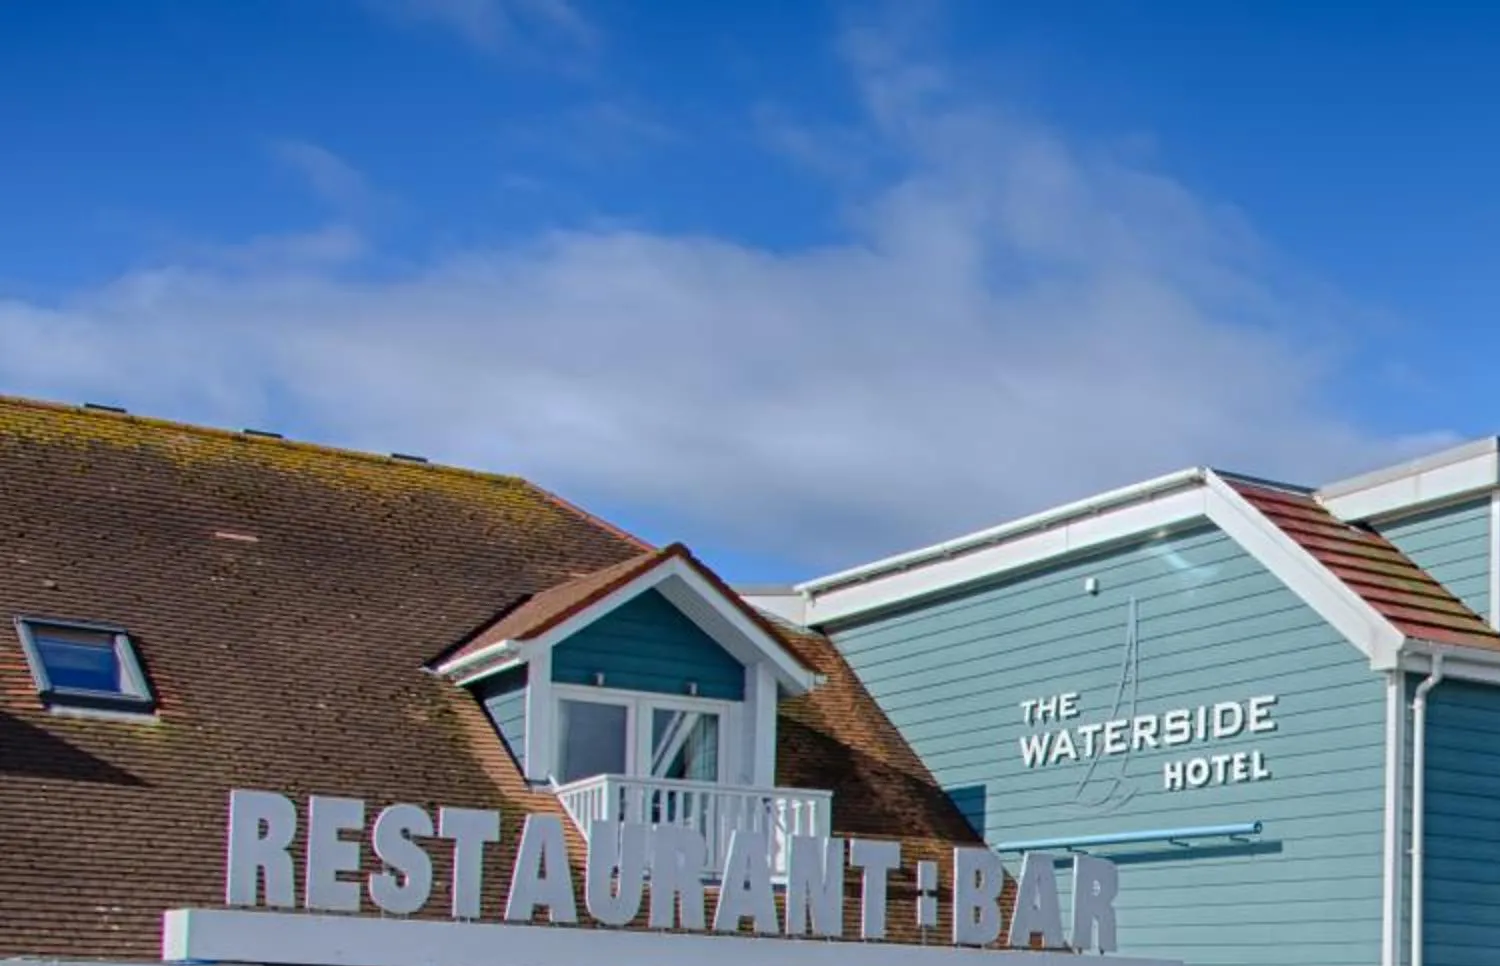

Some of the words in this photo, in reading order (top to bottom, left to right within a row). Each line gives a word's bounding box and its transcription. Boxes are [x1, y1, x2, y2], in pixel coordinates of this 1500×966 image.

[1020, 692, 1079, 725] THE
[1019, 695, 1278, 768] WATERSIDE
[1164, 749, 1271, 791] HOTEL
